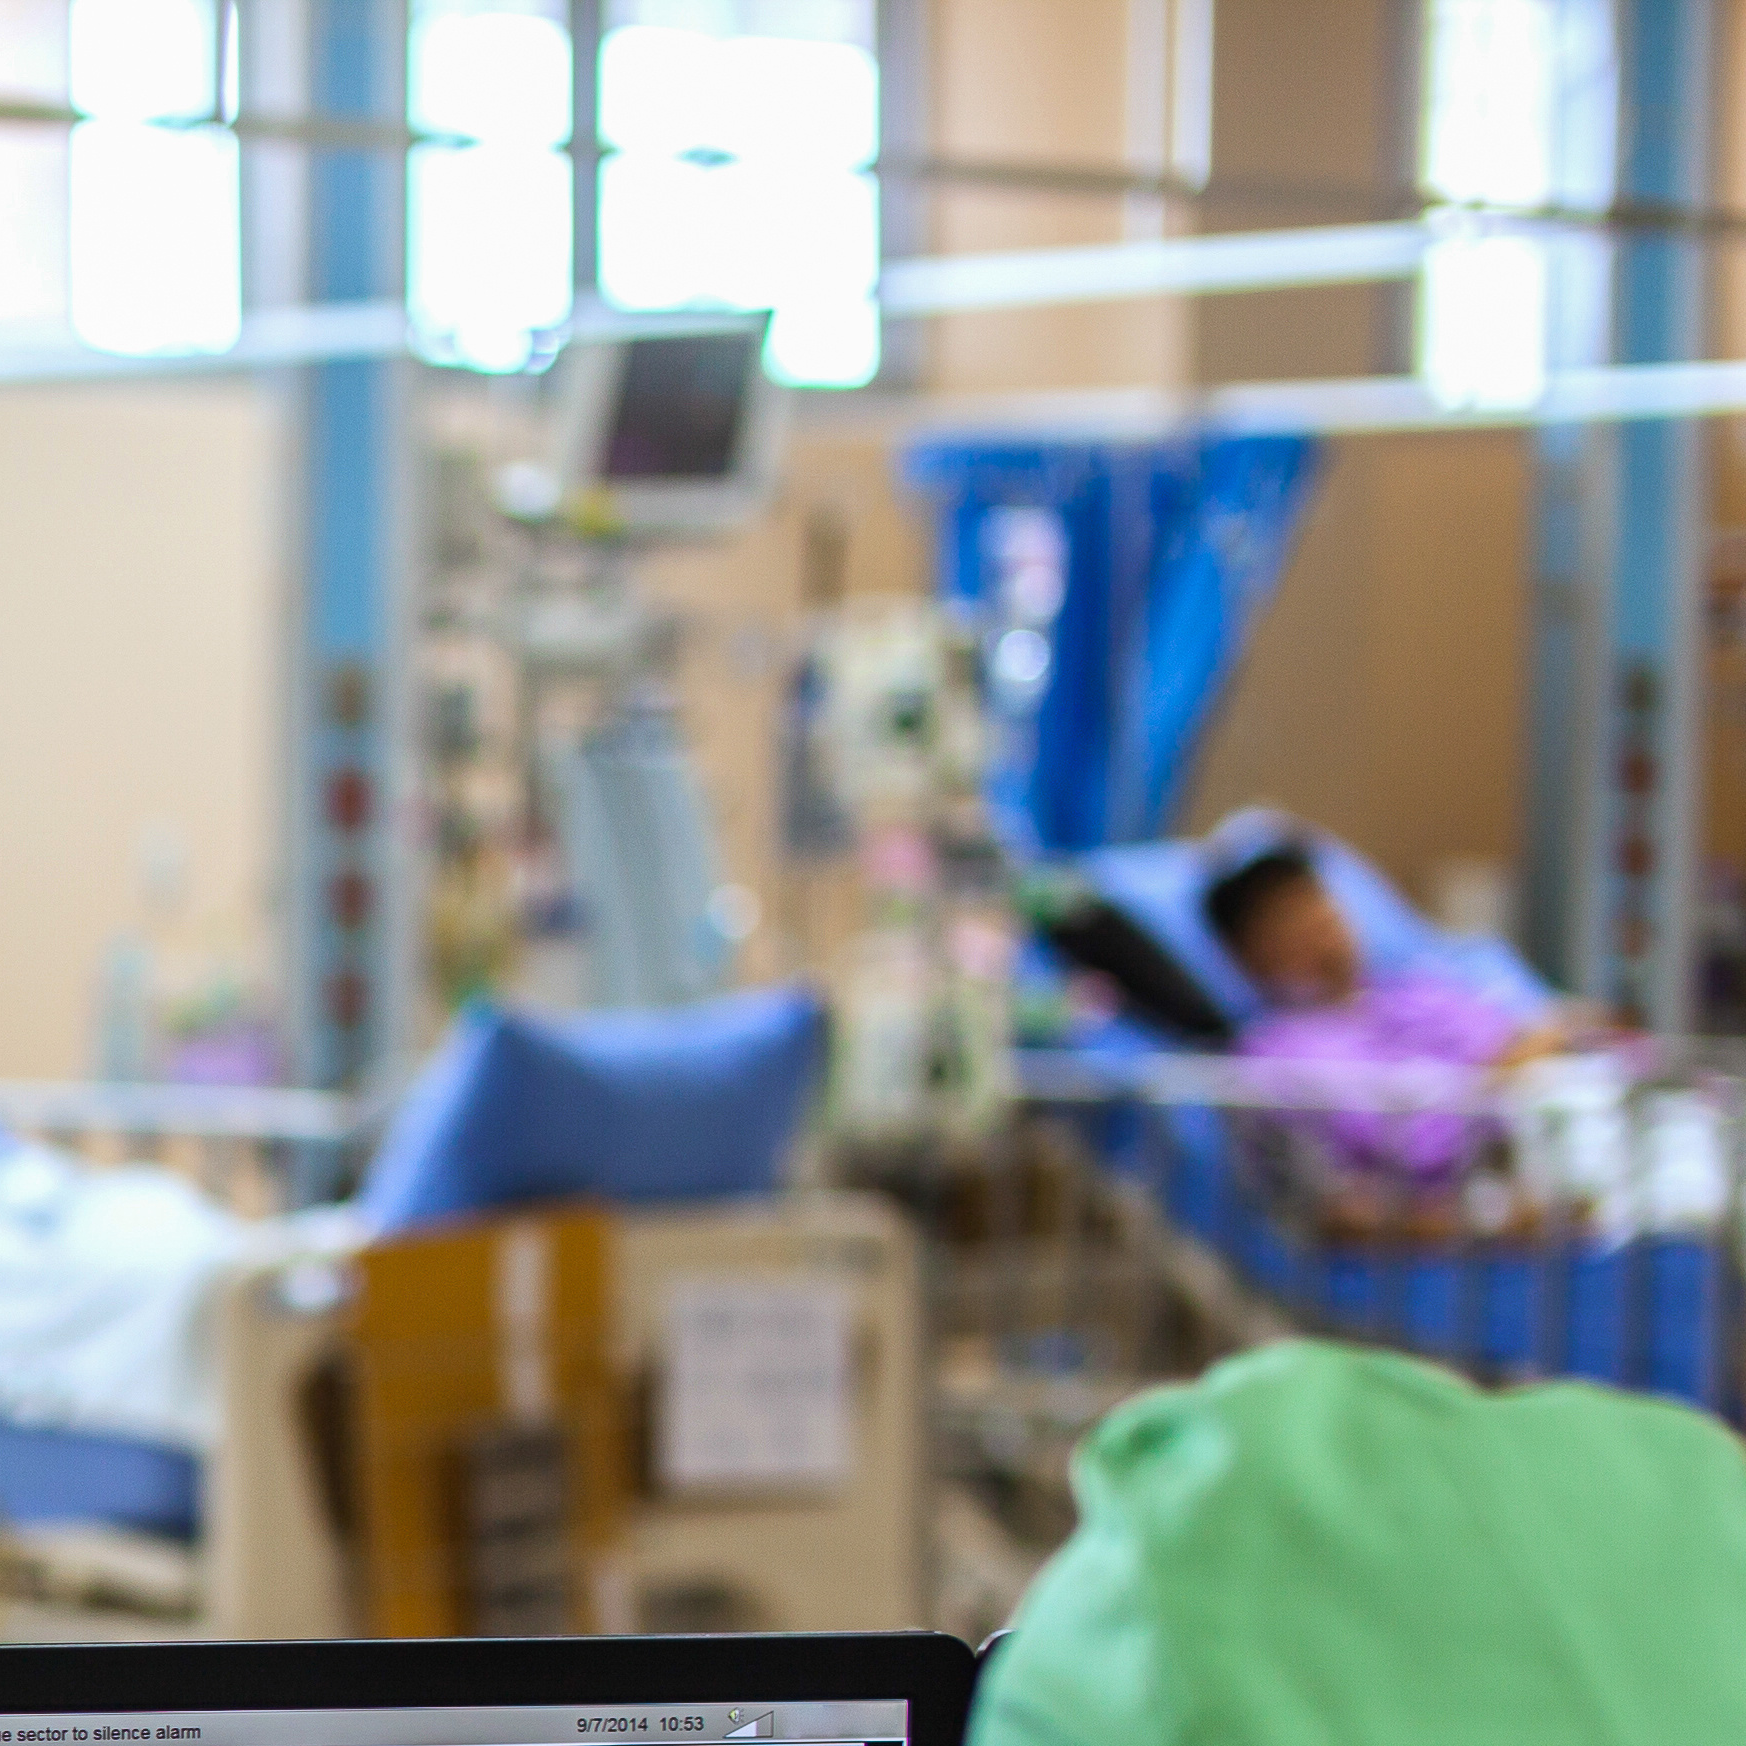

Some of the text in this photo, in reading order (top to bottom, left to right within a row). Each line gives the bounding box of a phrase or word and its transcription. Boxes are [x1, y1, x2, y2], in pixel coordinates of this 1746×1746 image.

[578, 1716, 704, 1733] 9/7/2014 10:53
[17, 1727, 68, 1741] sector
[72, 1727, 88, 1740] to
[94, 1727, 150, 1740] silence
[156, 1726, 200, 1739] alarm
